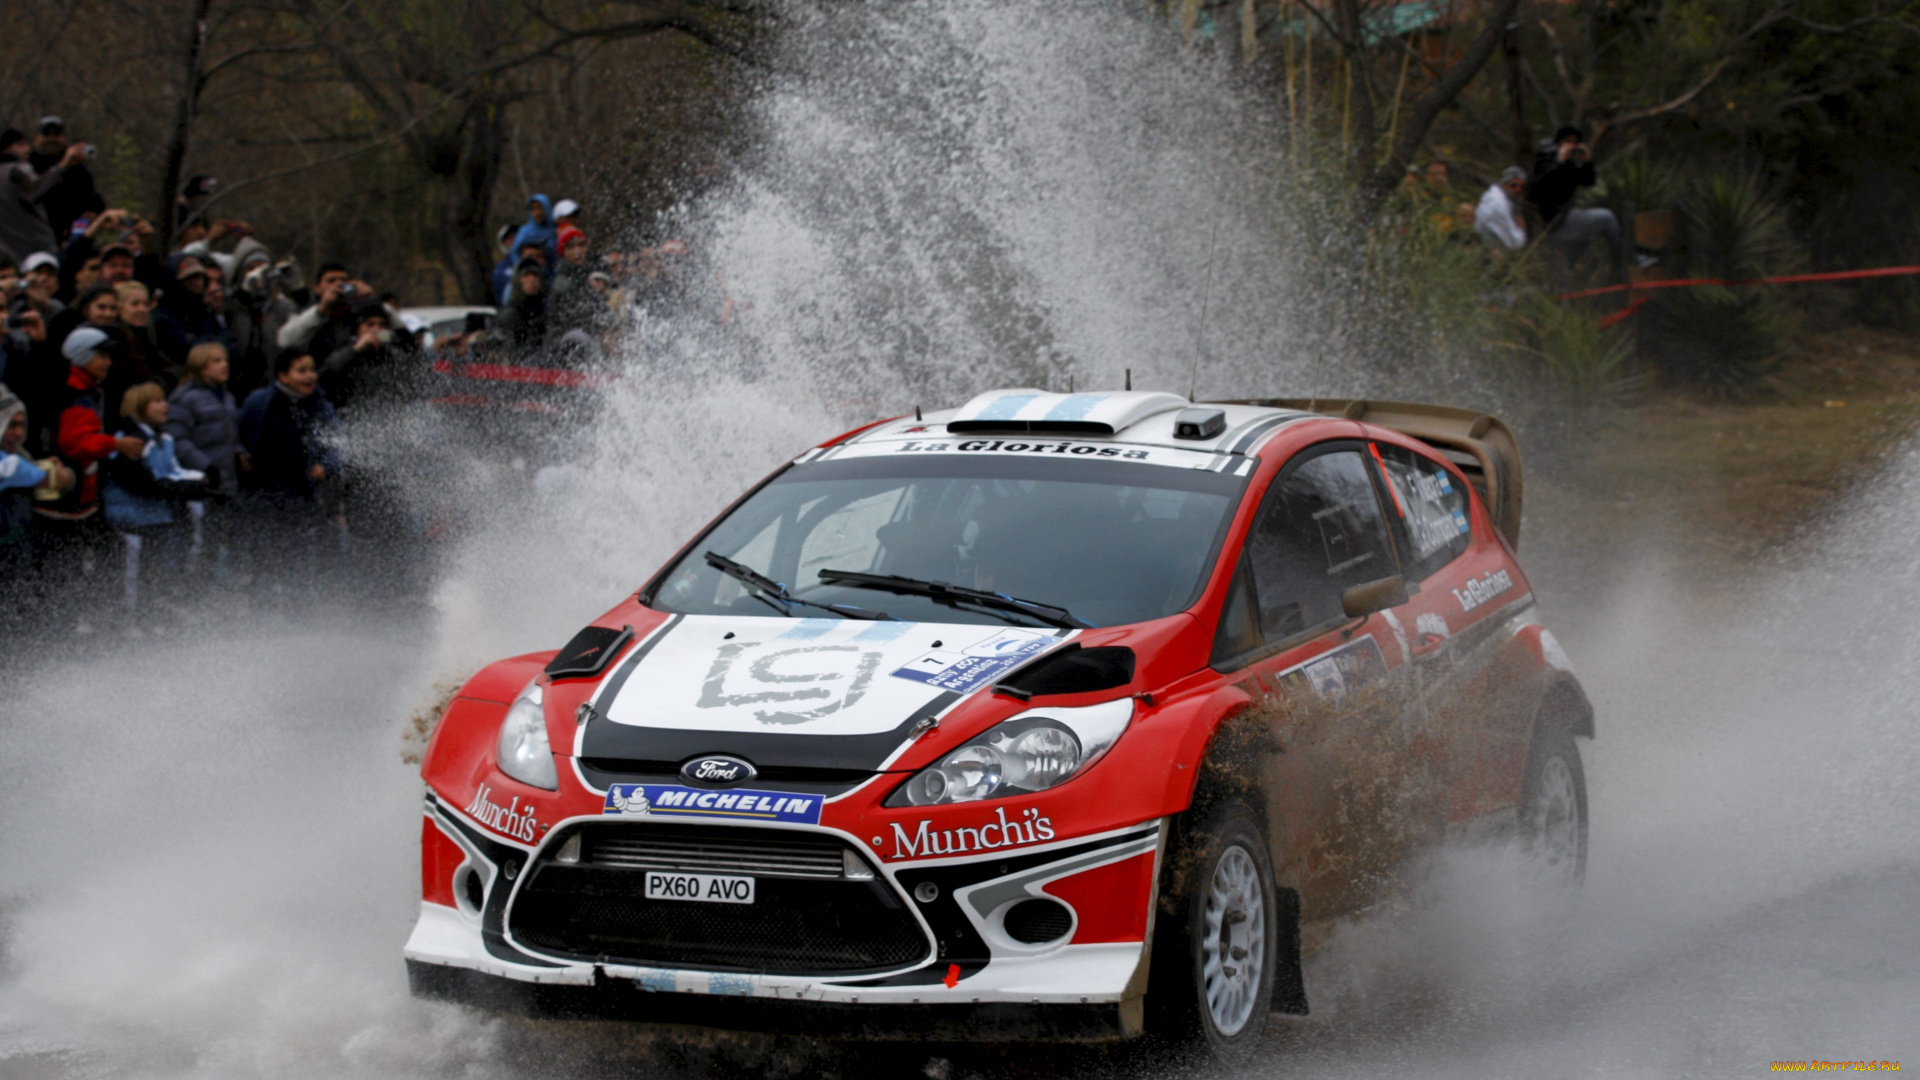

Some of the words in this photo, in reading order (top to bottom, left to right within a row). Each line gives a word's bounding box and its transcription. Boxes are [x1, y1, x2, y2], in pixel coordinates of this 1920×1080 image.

[895, 441, 950, 452] La
[957, 440, 1150, 460] Gloriosa
[694, 760, 737, 780] Ford
[464, 782, 537, 843] Munchi's
[655, 790, 814, 814] MICHELIN
[889, 806, 1055, 859] Munchi's
[649, 876, 699, 898] PX60
[707, 877, 751, 900] AVO
